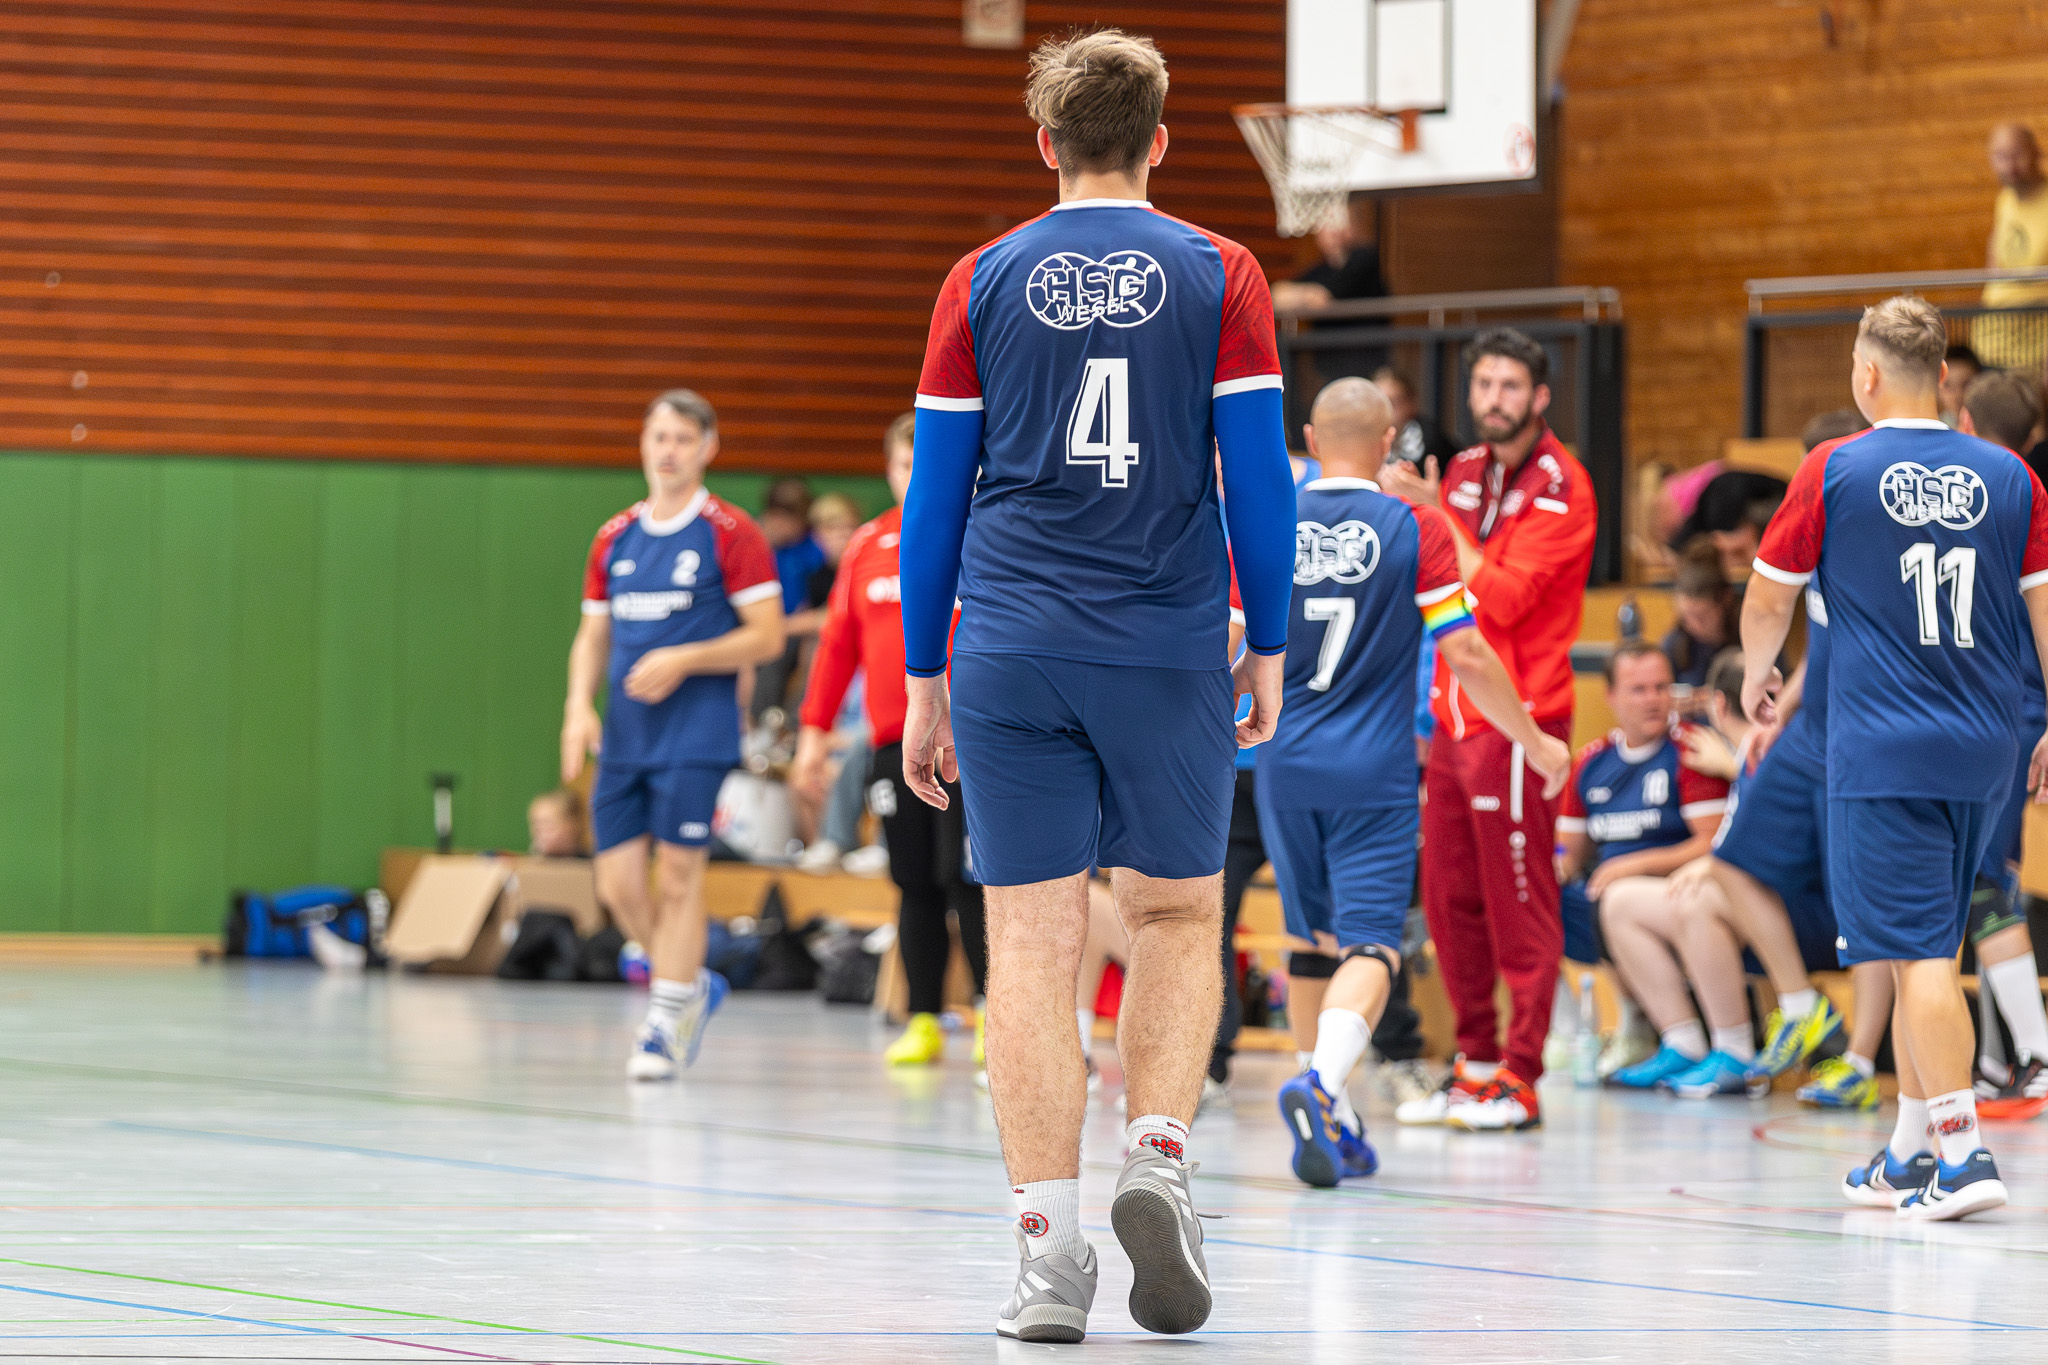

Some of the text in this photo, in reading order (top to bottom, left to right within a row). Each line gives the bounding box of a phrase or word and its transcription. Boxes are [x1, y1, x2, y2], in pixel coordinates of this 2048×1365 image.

[1045, 263, 1148, 306] HSG
[1056, 297, 1129, 322] WESEL
[1066, 358, 1139, 488] 4
[1896, 473, 1974, 510] HSG
[671, 549, 701, 587] 2
[1899, 542, 1976, 649] 11
[1304, 597, 1356, 692] 7
